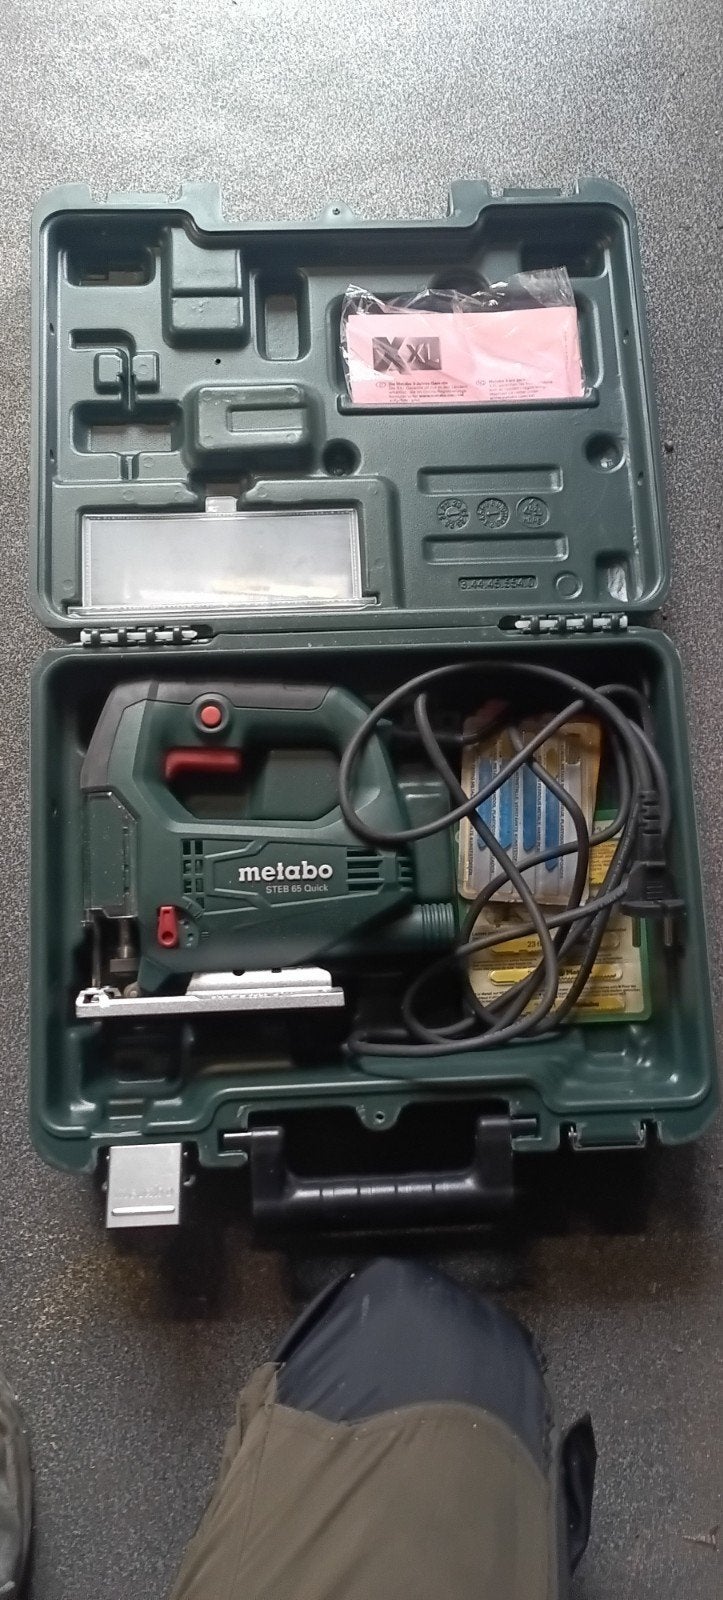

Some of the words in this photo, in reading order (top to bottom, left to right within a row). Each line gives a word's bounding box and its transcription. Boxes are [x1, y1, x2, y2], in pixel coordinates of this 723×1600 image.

[238, 860, 333, 882] metabo
[265, 885, 290, 894] STEB
[291, 884, 302, 893] 65
[303, 883, 329, 893] Quick
